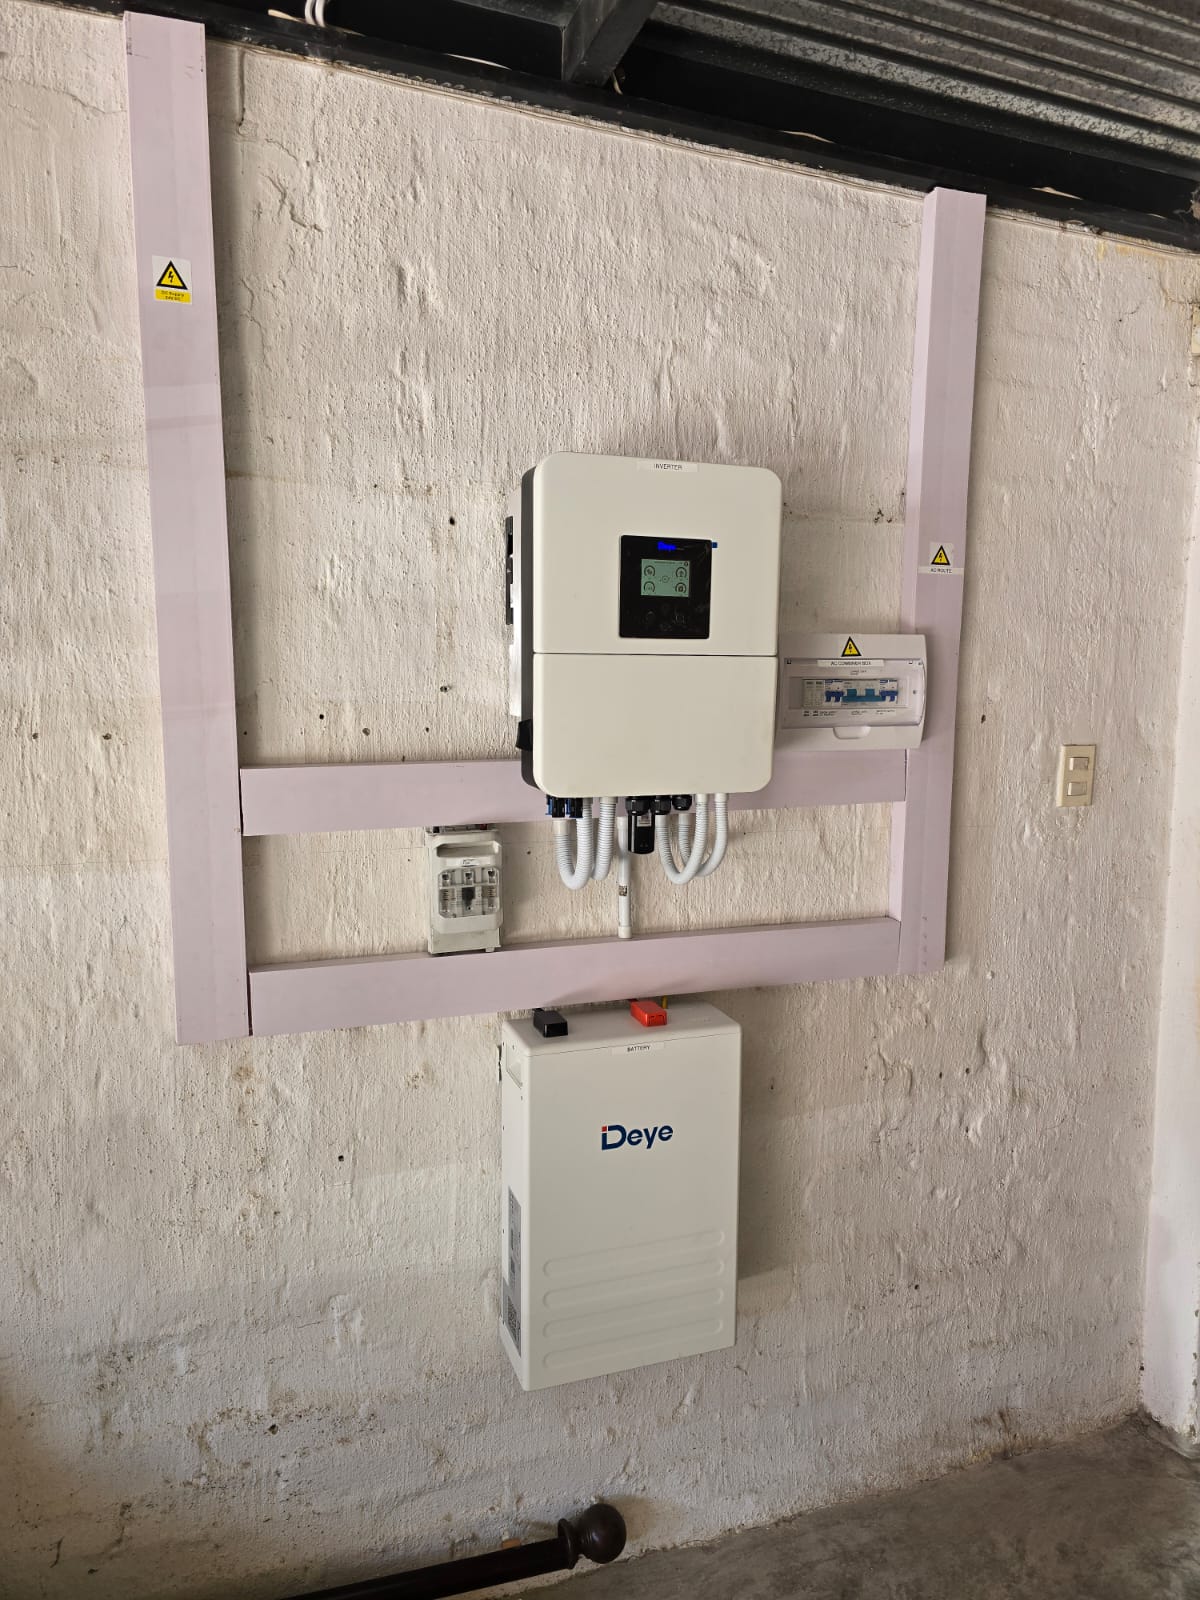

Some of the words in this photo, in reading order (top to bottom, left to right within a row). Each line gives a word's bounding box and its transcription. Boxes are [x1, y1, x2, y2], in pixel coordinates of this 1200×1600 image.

[654, 463, 683, 471] INVERTER
[627, 1045, 651, 1053] BATTERY
[601, 1123, 674, 1151] Deye
